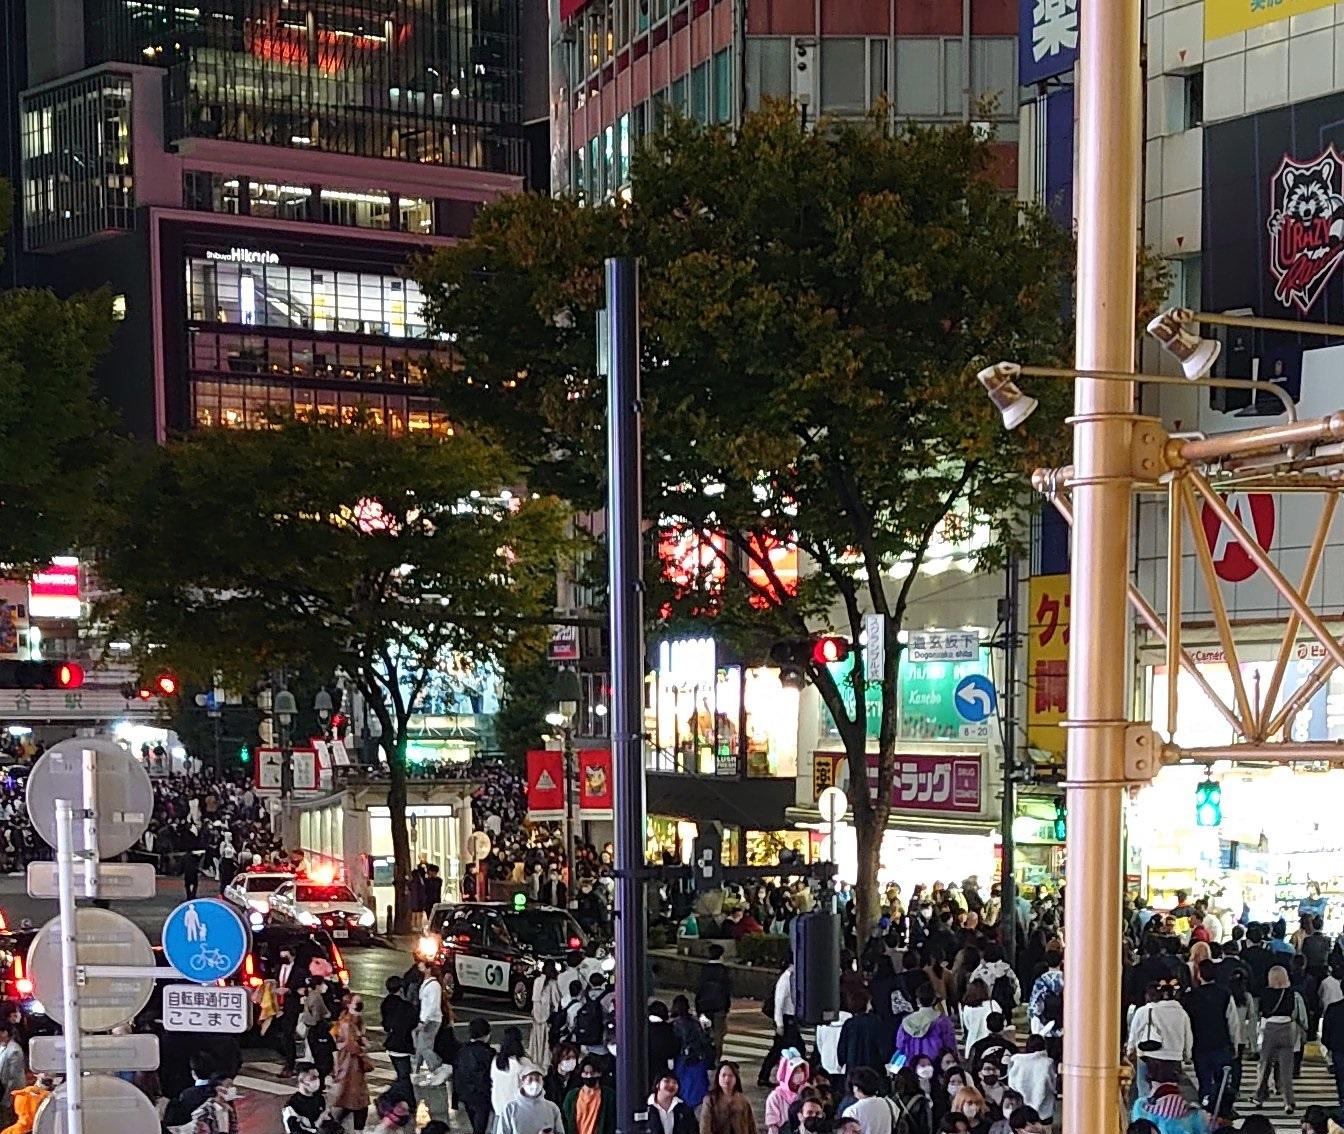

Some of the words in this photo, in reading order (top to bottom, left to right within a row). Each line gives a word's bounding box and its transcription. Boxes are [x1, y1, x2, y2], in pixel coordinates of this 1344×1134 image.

[912, 634, 973, 649] 道玄坂下
[485, 963, 504, 987] GO
[168, 992, 243, 1008] 自転車通行可
[169, 1011, 243, 1028] ここまで
